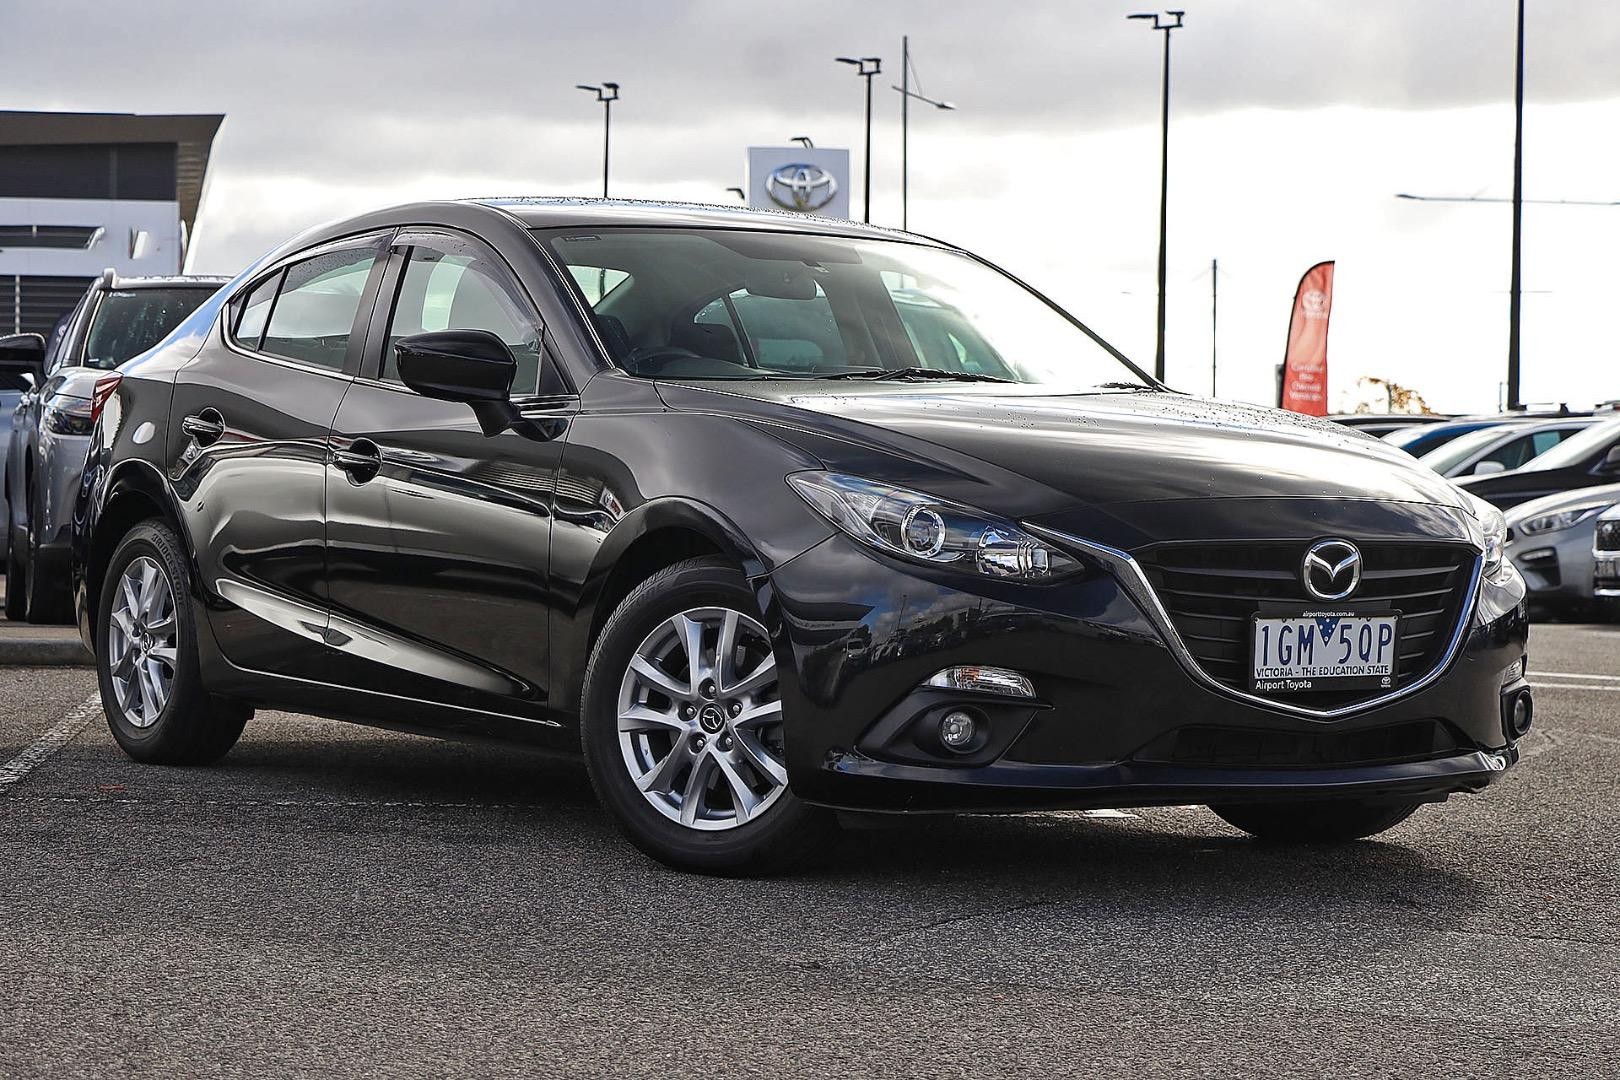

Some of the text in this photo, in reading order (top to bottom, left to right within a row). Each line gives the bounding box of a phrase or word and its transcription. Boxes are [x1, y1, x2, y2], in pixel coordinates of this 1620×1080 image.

[1302, 610, 1355, 618] airporttoyota.com.au
[1261, 623, 1393, 666] 1GM 5QP
[1256, 667, 1293, 678] VICTORIA
[1301, 666, 1317, 677] THE
[1318, 665, 1365, 676] EDUCATION
[1366, 664, 1389, 675] STATE
[1255, 679, 1312, 691] Airport Toyota
